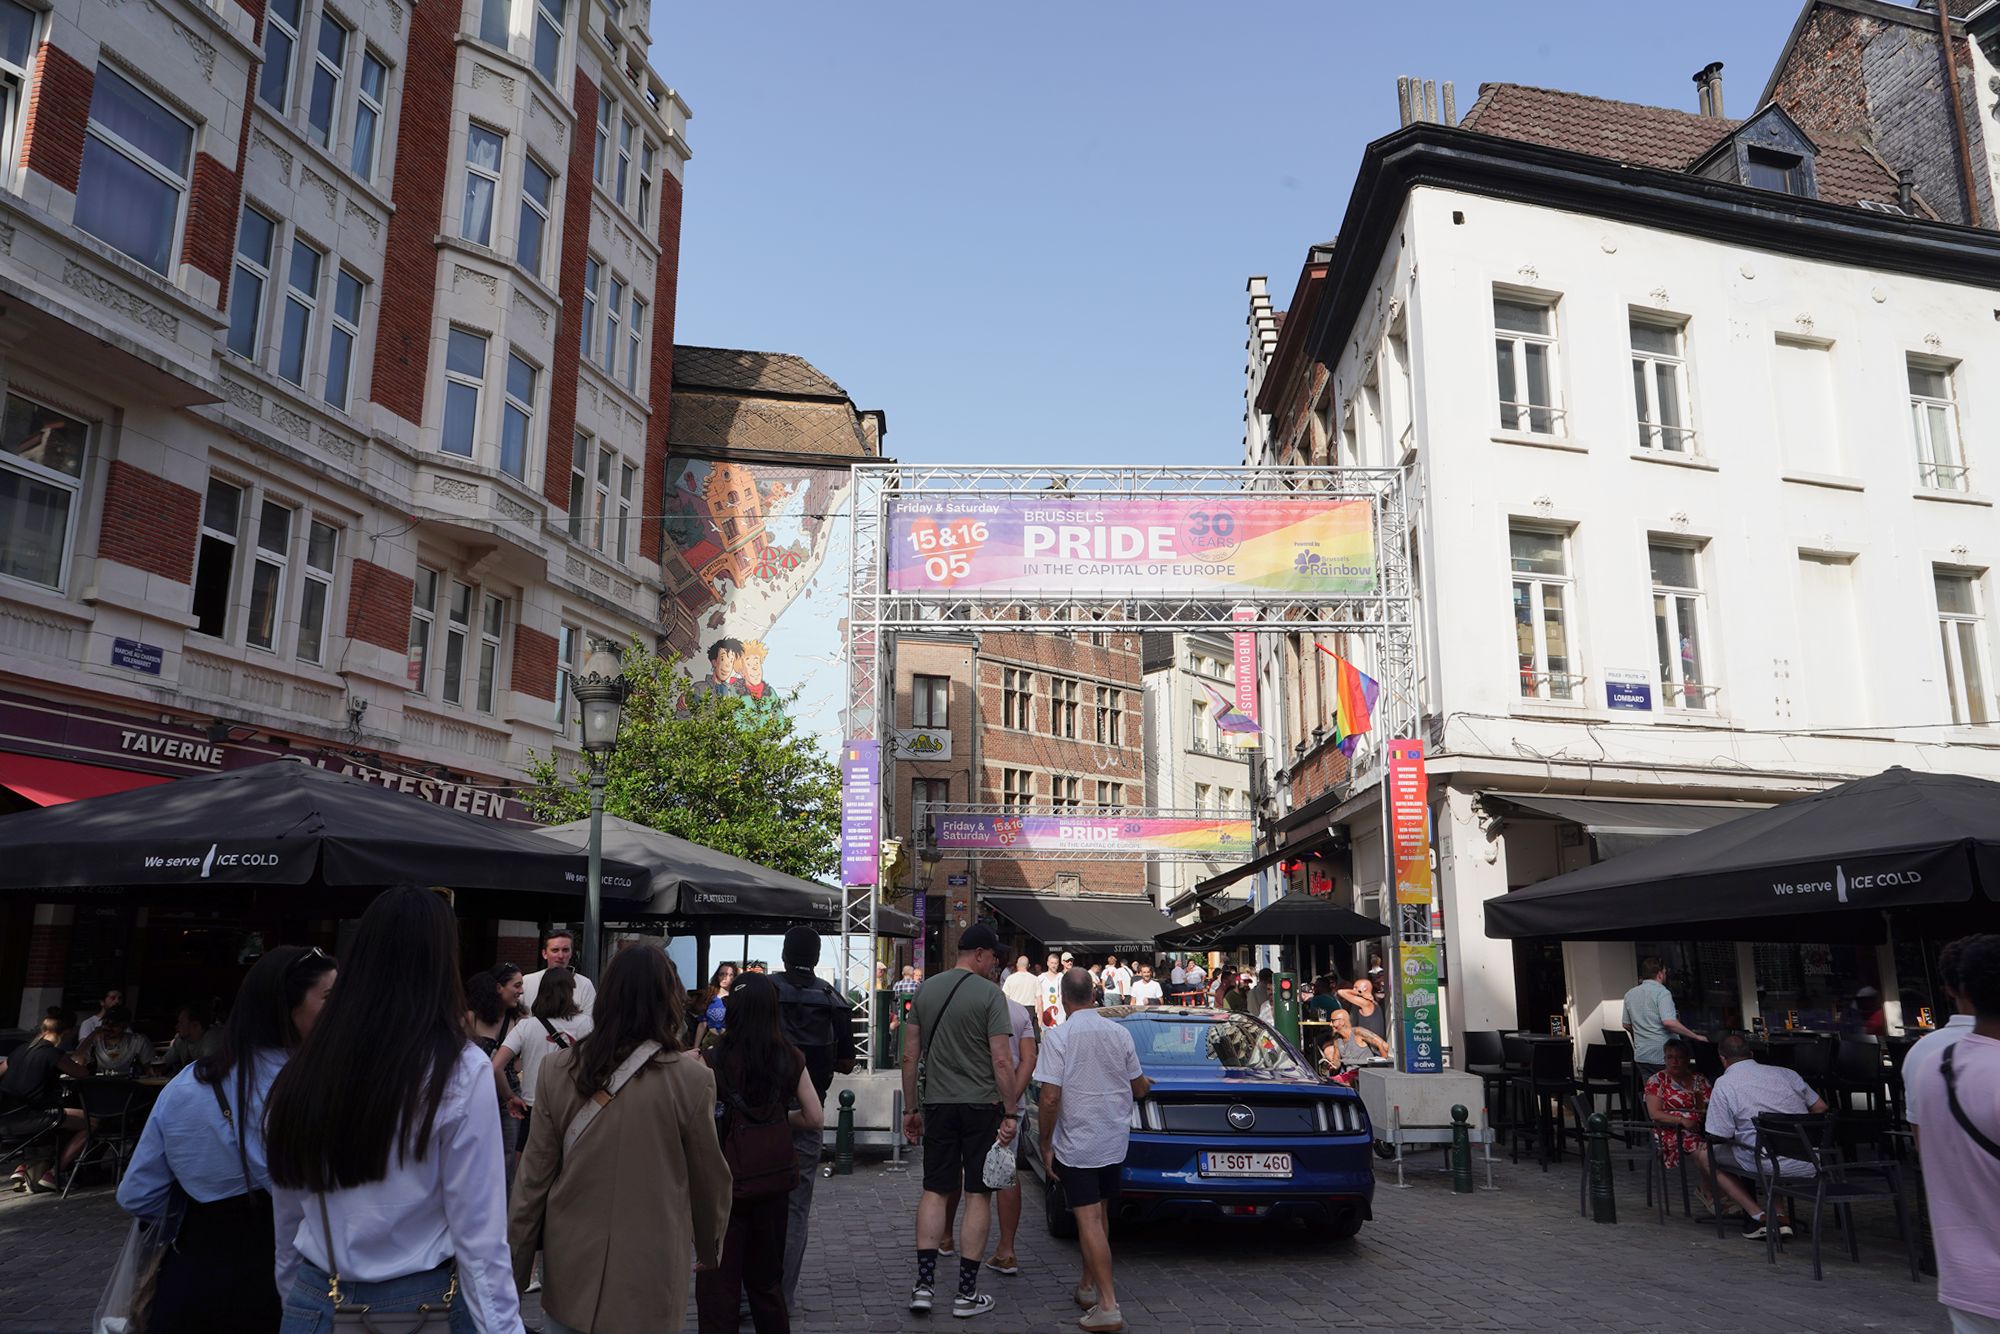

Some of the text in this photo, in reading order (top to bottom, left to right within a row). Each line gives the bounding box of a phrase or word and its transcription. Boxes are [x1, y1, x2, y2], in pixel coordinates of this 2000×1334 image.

[896, 503, 1000, 514] Friday & Saturday
[1024, 510, 1104, 523] BRUSSELS
[1188, 511, 1235, 537] 30
[907, 521, 990, 551] 15&16
[1023, 525, 1178, 560] PRIDE
[1188, 536, 1235, 548] YEARS
[925, 553, 970, 582] 05
[1023, 563, 1235, 576] IN THE CAPITAL OF EUROPE
[1310, 563, 1371, 576] Rainbow
[1613, 694, 1645, 703] LOMBARD
[121, 730, 225, 765] TAVERNE
[943, 821, 985, 832] Friday &
[992, 820, 1024, 832] 15&16
[1124, 823, 1141, 833] 30
[943, 831, 991, 842] Saturday
[999, 832, 1017, 844] 05
[1059, 826, 1119, 840] PRIDE
[145, 854, 279, 867] We serve ICE COLD
[565, 871, 575, 882] We
[601, 876, 613, 885] ICE
[613, 877, 632, 887] COLD
[1773, 871, 1922, 896] We serve ICE COLD
[694, 894, 703, 903] LE
[1284, 1003, 1289, 1011] 1
[1419, 1060, 1436, 1068] alive
